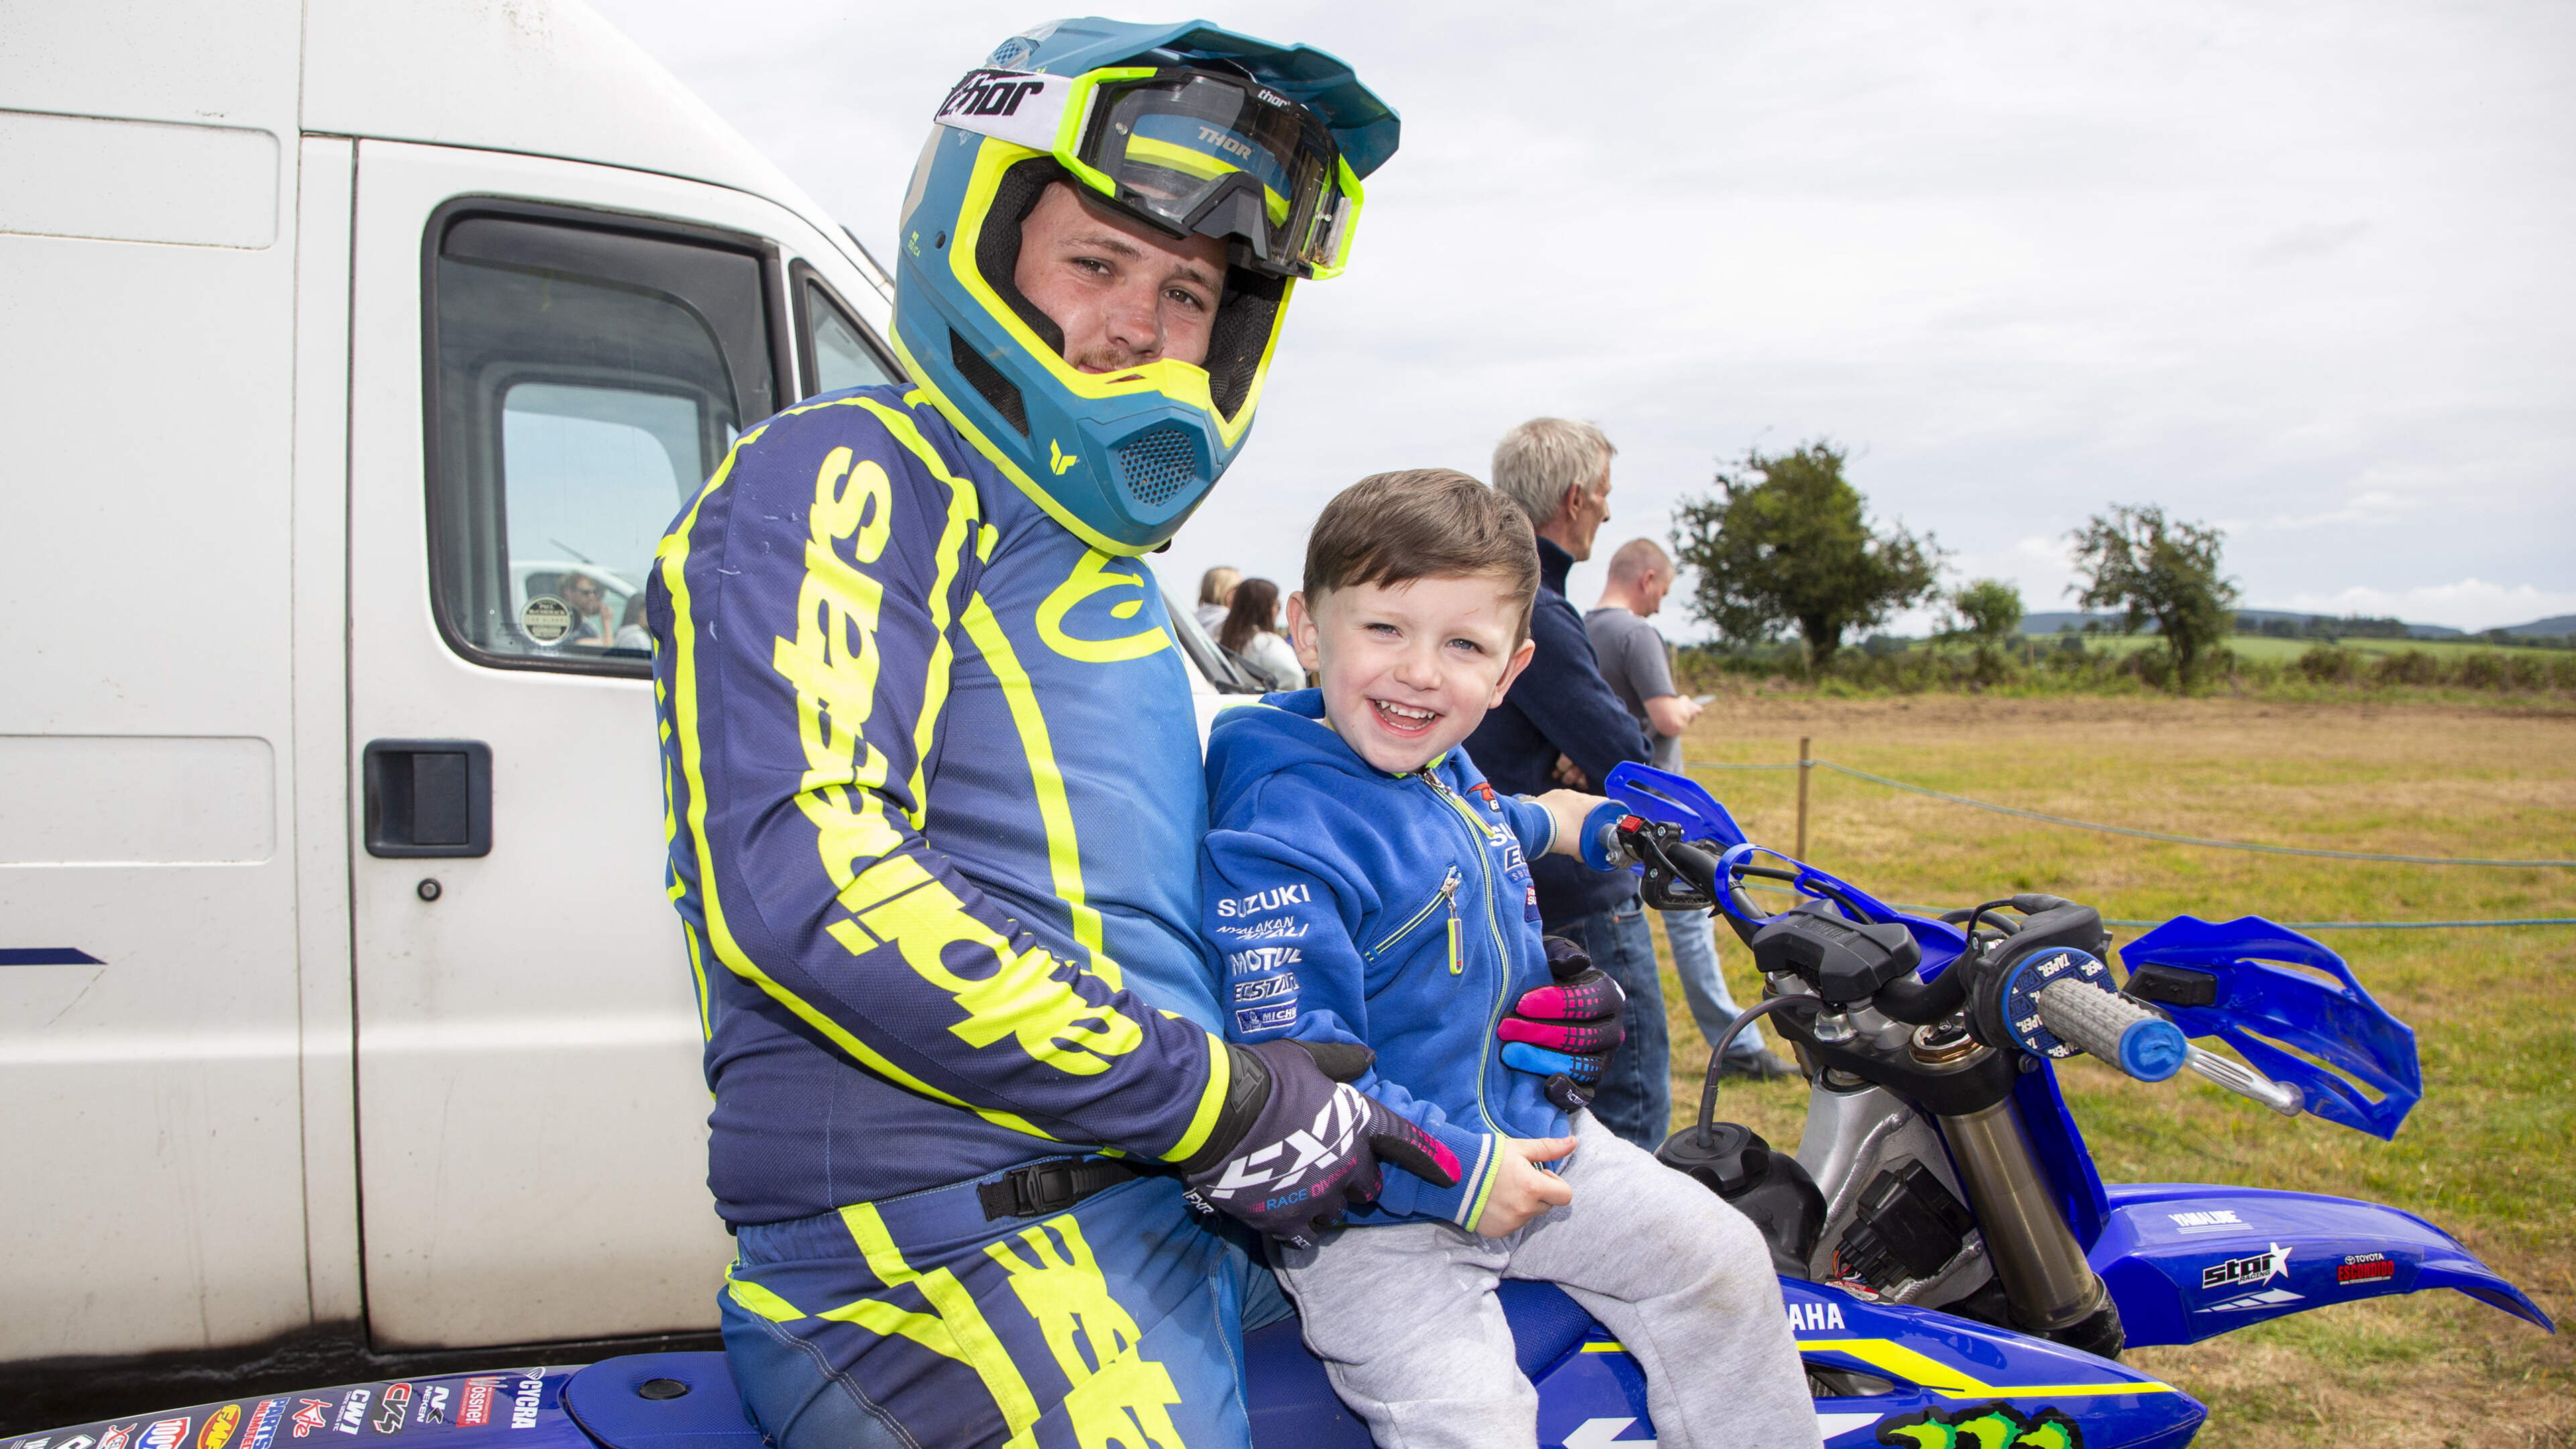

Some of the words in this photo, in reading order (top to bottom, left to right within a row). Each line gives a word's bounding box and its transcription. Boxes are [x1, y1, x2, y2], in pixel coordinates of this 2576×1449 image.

[1197, 125, 1253, 161] THOR
[1217, 883, 1311, 918] SUZUKI
[1228, 947, 1303, 977] MOTUL
[1234, 973, 1299, 1002] ECSTAR
[1267, 1188, 1308, 1211] RACE
[2168, 1210, 2243, 1227] YAMALUBE
[2203, 1254, 2277, 1287] star
[2338, 1259, 2394, 1281] ESCONDIDO
[2355, 1252, 2385, 1263] TOYOTA
[2239, 1270, 2271, 1283] RACING
[417, 1385, 433, 1423] NEKEN
[511, 1380, 543, 1429] CYCRA
[252, 1397, 291, 1449] PARTS
